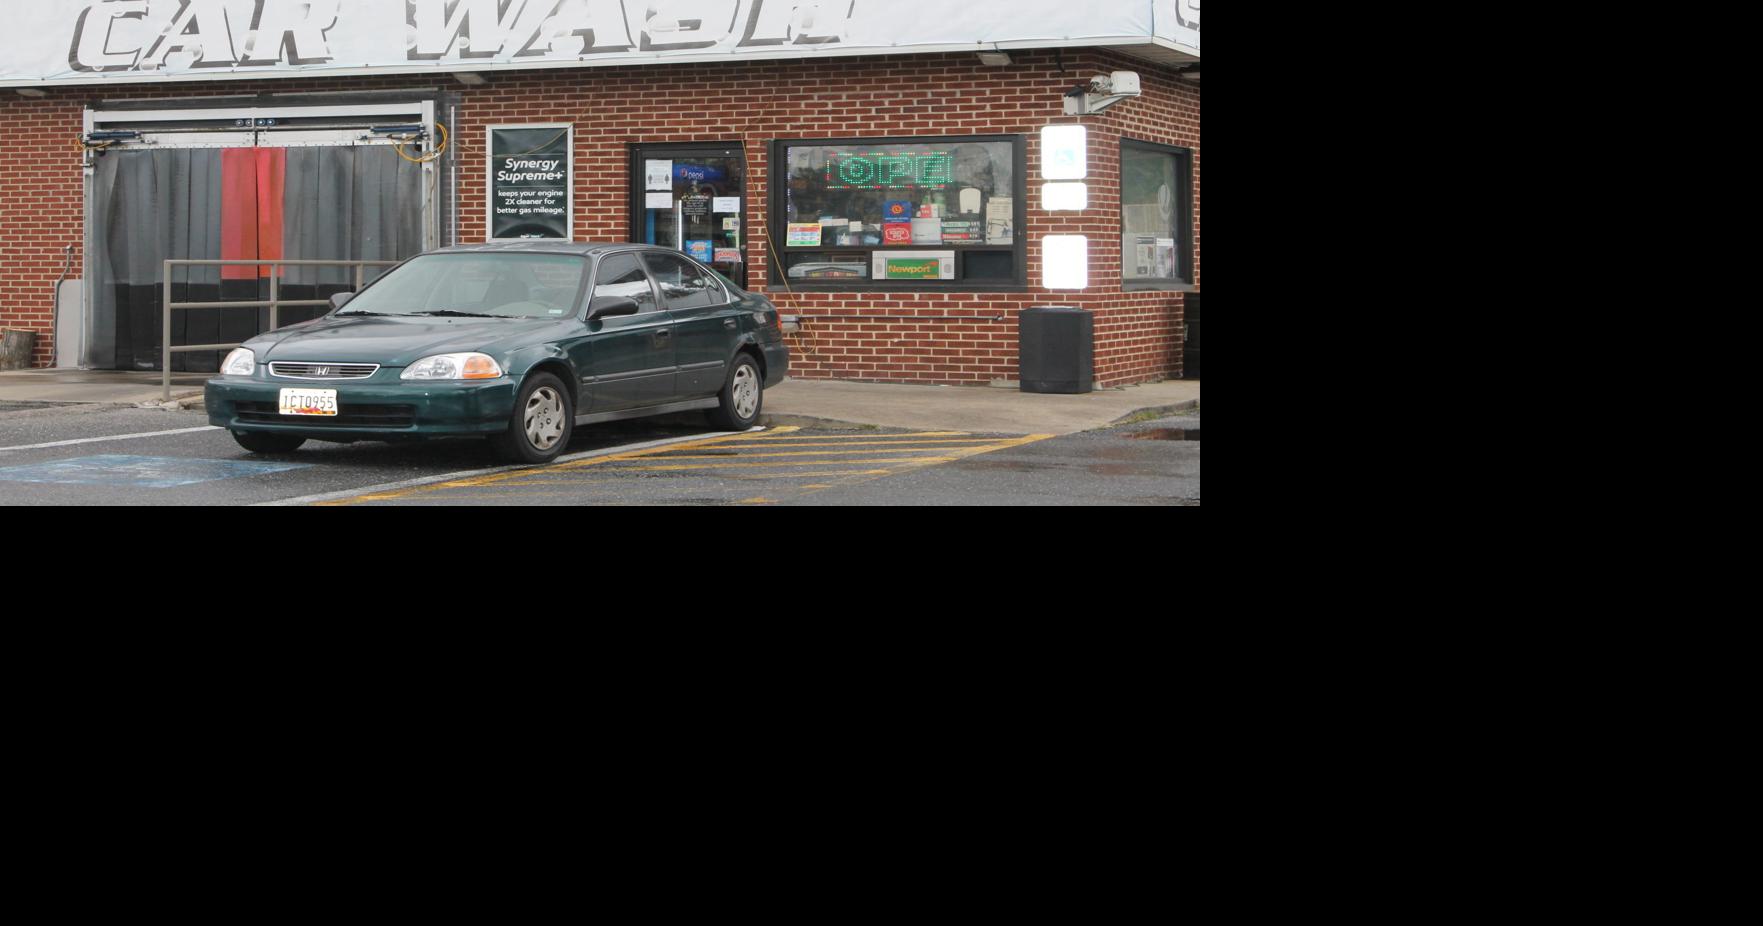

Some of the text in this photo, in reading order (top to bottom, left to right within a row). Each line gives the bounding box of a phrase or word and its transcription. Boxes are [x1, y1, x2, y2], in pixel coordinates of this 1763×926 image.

[68, 0, 341, 71] CAR
[505, 158, 559, 172] Synergy
[839, 156, 953, 184] OPE
[537, 190, 564, 198] engine
[544, 197, 555, 205] for
[888, 263, 931, 274] Newport
[284, 395, 334, 409] 1CT0955
